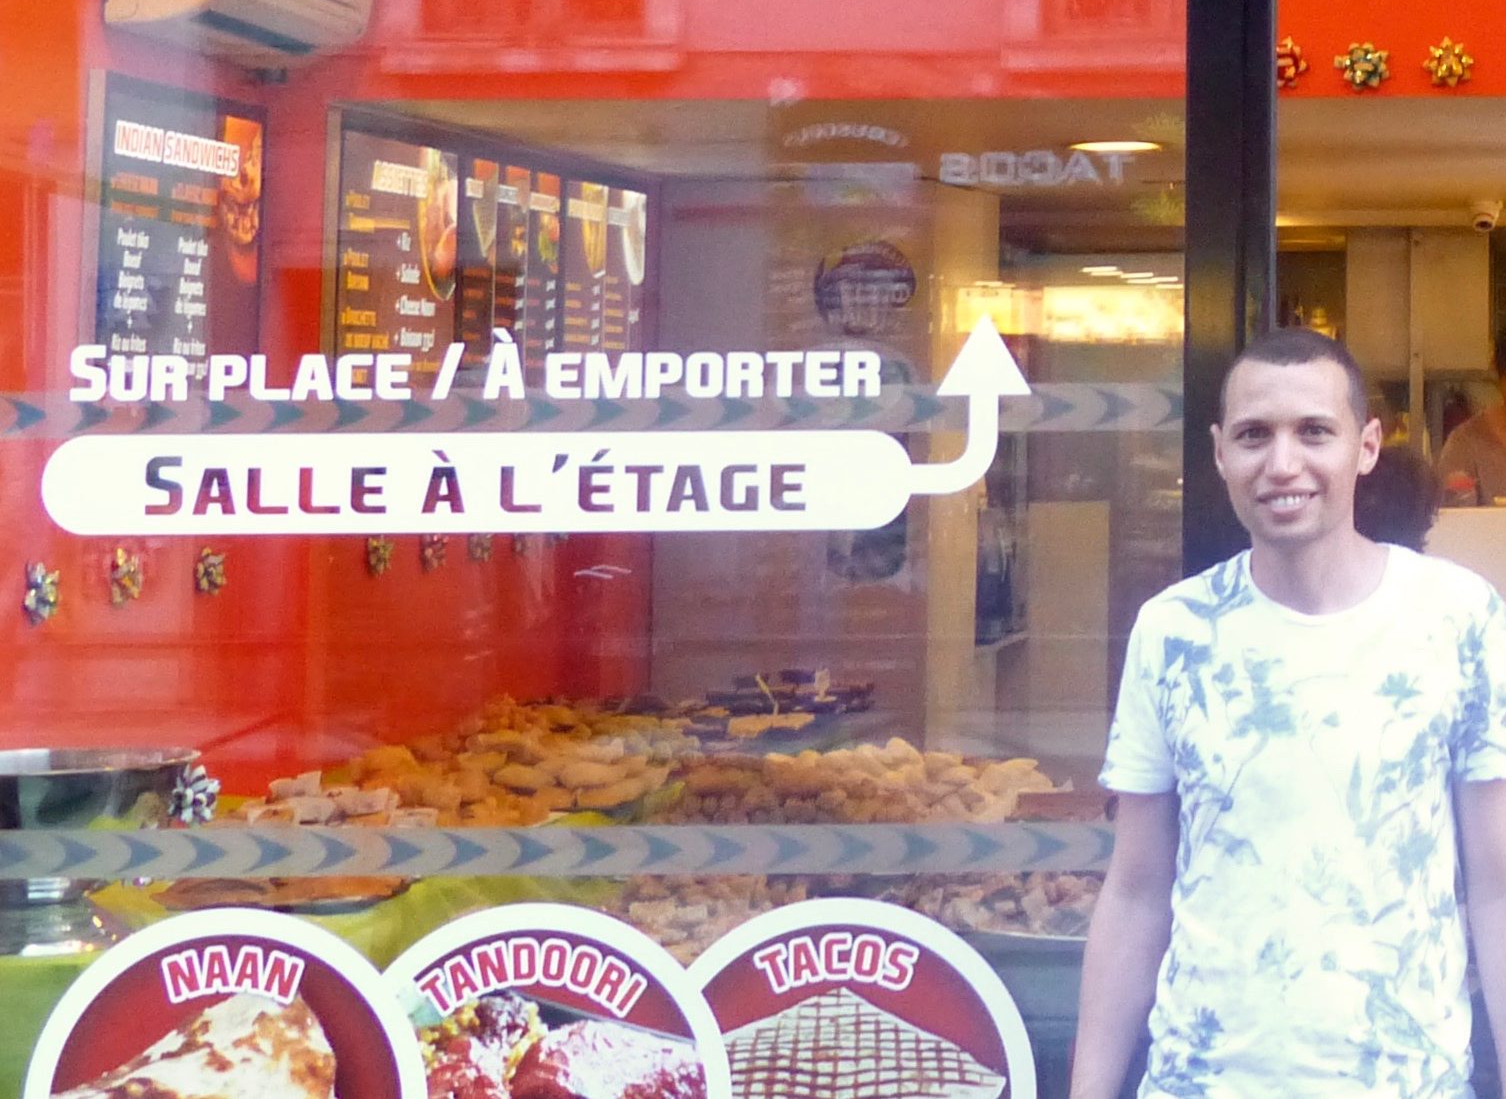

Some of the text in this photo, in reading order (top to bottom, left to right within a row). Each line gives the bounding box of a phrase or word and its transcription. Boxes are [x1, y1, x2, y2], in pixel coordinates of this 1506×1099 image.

[114, 119, 164, 162] INDIAN
[70, 344, 188, 402] SUR
[209, 353, 411, 401] PLACE
[484, 327, 524, 400] À
[545, 351, 881, 399] EMPORTER
[145, 455, 387, 516] SALLE
[421, 450, 464, 514] À
[162, 944, 304, 1005] NAAN
[417, 936, 648, 1019] TANDOORI
[753, 932, 919, 993] TACOS
